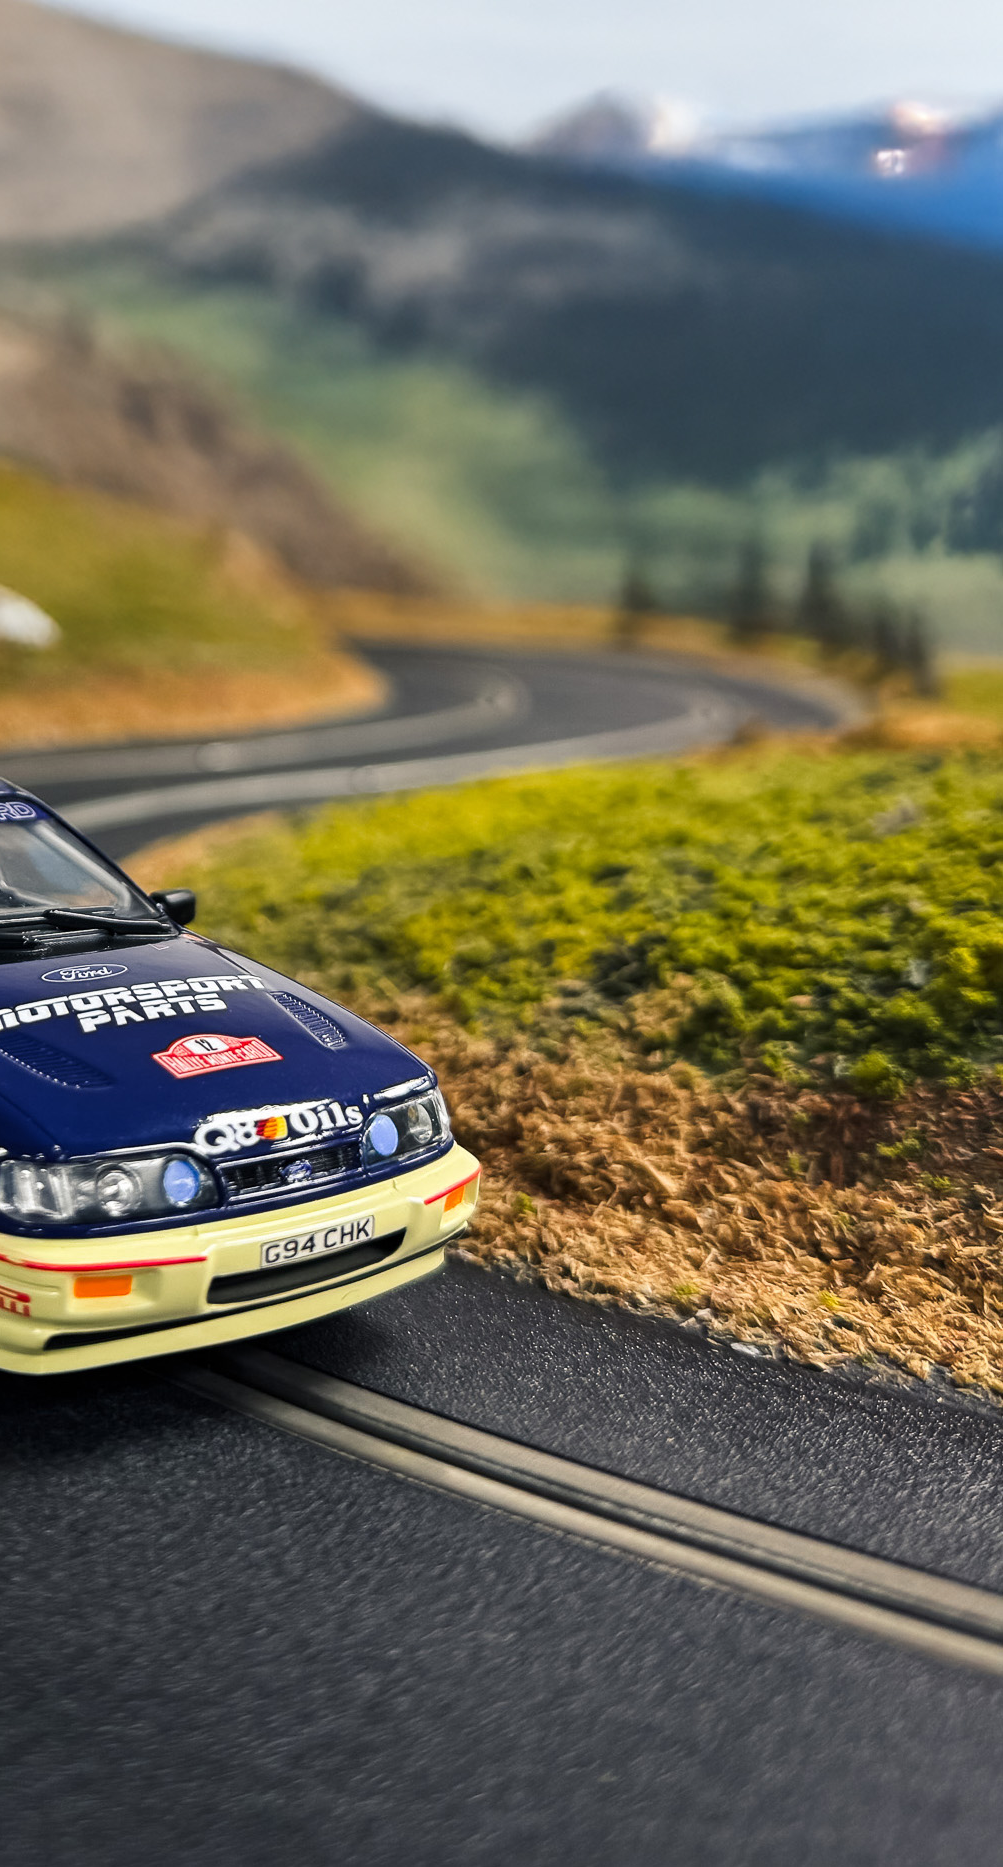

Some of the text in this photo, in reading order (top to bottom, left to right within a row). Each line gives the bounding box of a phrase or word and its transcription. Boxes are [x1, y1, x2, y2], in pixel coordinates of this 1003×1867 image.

[60, 966, 113, 981] Ford
[77, 993, 228, 1033] PARTS
[195, 1039, 218, 1051] 12
[161, 1055, 211, 1074] RALLYE
[194, 1101, 364, 1156] Q8 Oils
[265, 1217, 371, 1264] G94 CHK
